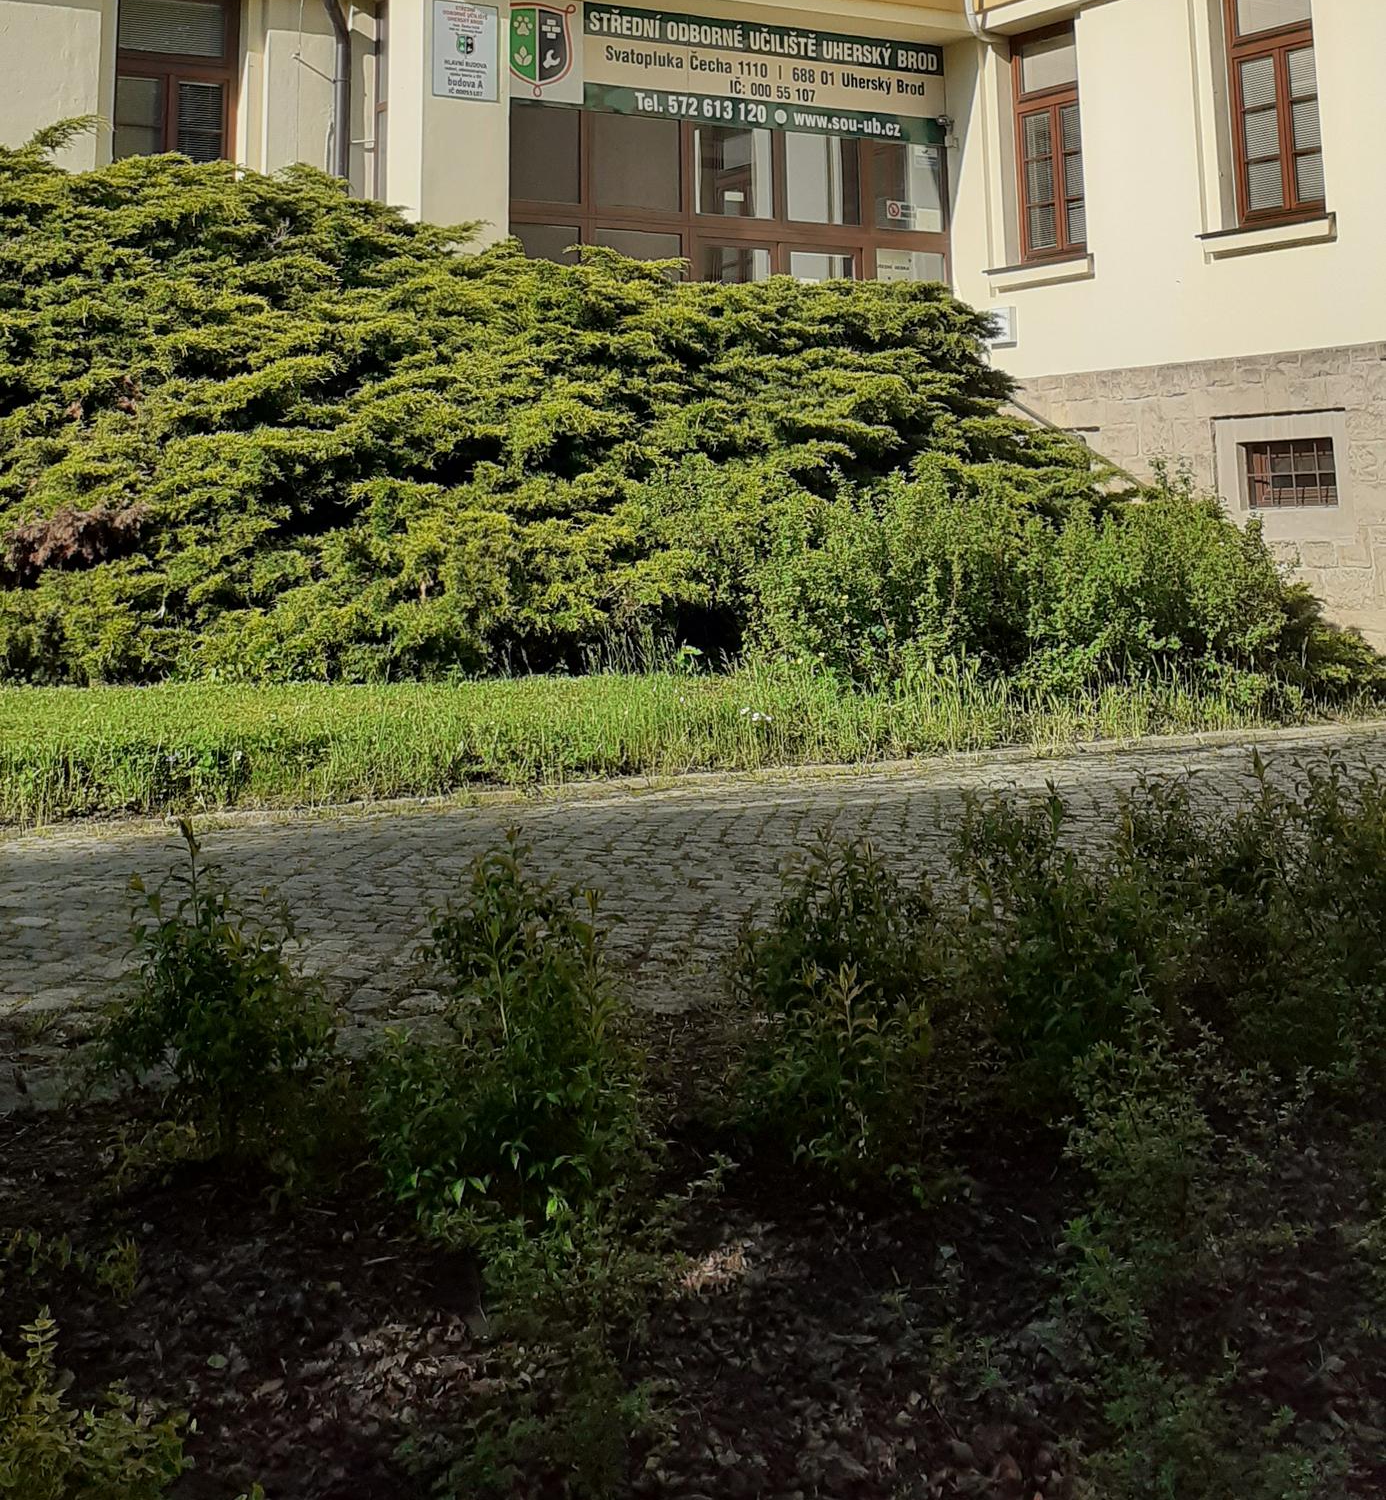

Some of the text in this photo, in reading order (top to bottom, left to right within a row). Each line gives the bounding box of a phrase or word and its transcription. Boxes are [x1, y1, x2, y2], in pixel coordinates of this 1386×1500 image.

[589, 9, 938, 71] STŘEDNÍ ODBORNÉ UČILIŠTĚ UHERSKÝ BROD
[447, 76, 484, 89] budova A
[605, 45, 684, 69] Svatopluka
[689, 51, 732, 74] Čecha
[738, 61, 768, 78] 1110
[792, 67, 815, 83] 688
[820, 71, 835, 86] 01
[841, 72, 892, 95] Uherský
[896, 79, 925, 96] Brod
[729, 77, 816, 103] IČ: 000 55 107
[635, 92, 901, 137] Tel. 572 613 120 www.sou-ub.cz
